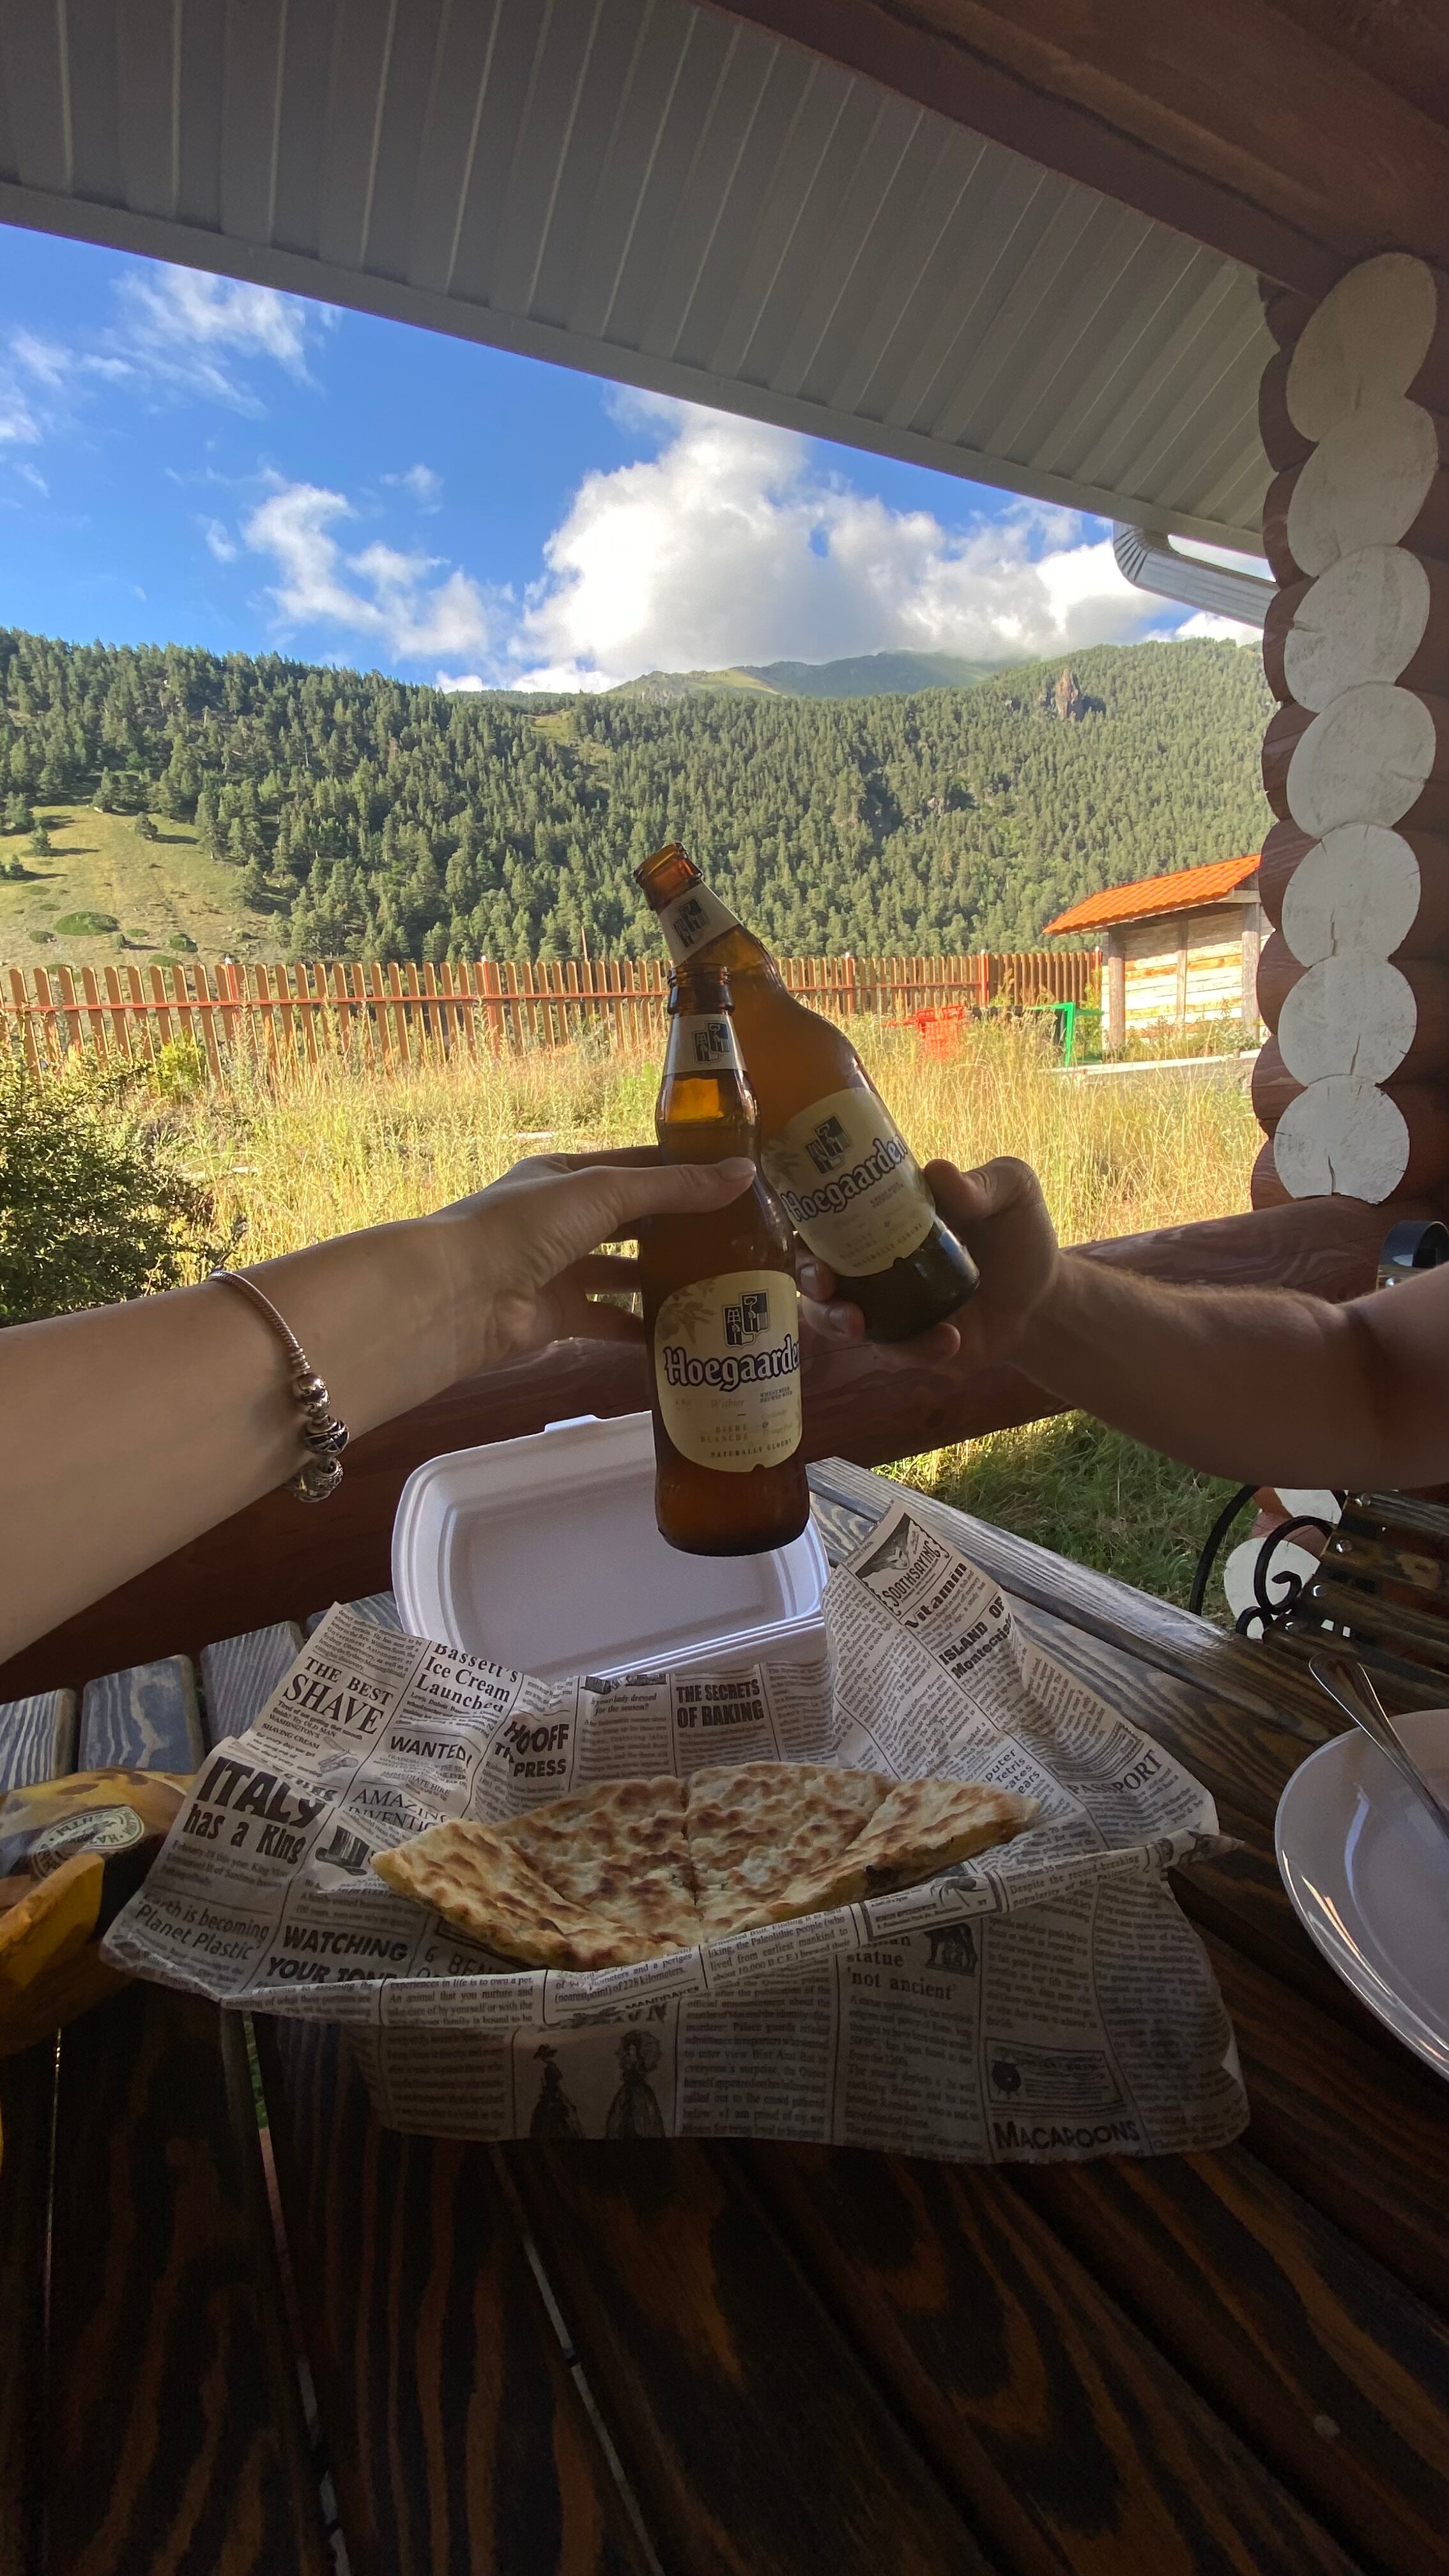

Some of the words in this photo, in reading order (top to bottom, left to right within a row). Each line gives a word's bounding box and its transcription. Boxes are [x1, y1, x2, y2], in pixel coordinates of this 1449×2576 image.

[780, 1133, 908, 1222] Hoegaarden
[710, 1446, 763, 1458] NATURALLY
[767, 1438, 792, 1452] CLOUDY
[882, 1540, 941, 1607] SOOTHSAYING
[905, 1563, 967, 1628] Vitamin
[938, 1621, 988, 1666] ISLAND
[988, 1596, 1006, 1618] OF
[871, 1642, 895, 1675] preparation
[305, 1657, 343, 1683] THE
[346, 1676, 394, 1706] BEST
[415, 1672, 505, 1713] Launched
[424, 1656, 451, 1678] Ice
[455, 1668, 510, 1703] Cream
[676, 1684, 703, 1703] THE
[704, 1679, 760, 1701] SECRETS
[282, 1673, 387, 1735] SHAVE
[631, 1693, 657, 1702] dressed
[677, 1706, 698, 1728] OF
[702, 1699, 765, 1726] BAKING
[261, 1723, 293, 1738] SHAVING
[293, 1735, 321, 1749] CREAM
[513, 1759, 567, 1777] PRESS
[985, 1749, 1016, 1783] puter
[995, 1758, 1026, 1783] Tetris
[1004, 1764, 1033, 1790] rates
[1068, 1749, 1163, 1794] PASSPORT
[196, 1756, 326, 1828] ITALY
[1017, 1770, 1040, 1794] ears
[182, 1803, 226, 1840] has
[230, 1820, 252, 1848] a
[256, 1824, 307, 1864] King
[1009, 1879, 1045, 1895] Despite
[1049, 1873, 1064, 1884] the
[1068, 1855, 1140, 1880] record-breaking
[1013, 1887, 1060, 1907] popularity
[1065, 1882, 1075, 1891] of
[183, 1905, 199, 1923] is
[199, 1907, 270, 1949] becoming
[737, 1941, 749, 1951] the
[751, 1929, 794, 1947] Paleolithic
[796, 1922, 824, 1936] people
[824, 1915, 845, 1928] (who
[192, 1931, 256, 1961] Plastic
[283, 1925, 410, 1961] WATCHING
[710, 1957, 733, 1972] lived
[737, 1952, 758, 1964] from
[763, 1942, 794, 1956] earliest
[799, 1929, 835, 1946] mankind
[839, 1928, 848, 1936] to
[266, 1956, 332, 1984] YOUR
[633, 1963, 649, 1975] and
[662, 1953, 693, 1969] perigee
[712, 1970, 737, 1981] about
[738, 1961, 766, 1975] 10,000
[800, 1946, 830, 1958] brewed
[832, 1939, 850, 1950] their
[847, 1951, 904, 1967] statue
[389, 1993, 402, 2003] An
[406, 1991, 435, 2004] animal
[440, 1990, 456, 2001] that
[461, 1991, 477, 2002] you
[482, 1990, 513, 1999] nurture
[518, 1986, 533, 1997] and
[390, 1981, 440, 1991] experiences
[442, 1979, 450, 1987] in
[452, 1978, 468, 1987] life
[470, 1978, 477, 1986] is
[555, 1990, 587, 2004] (nearest
[587, 1986, 613, 2002] point)
[613, 1984, 623, 1994] of
[624, 1979, 639, 1991] 228
[737, 1989, 751, 1998] the
[451, 2003, 487, 2016] yourself
[496, 2002, 518, 2012] with
[520, 2001, 533, 2010] the
[473, 2016, 480, 2025] is
[482, 2016, 509, 2025] bound
[992, 2119, 1142, 2150] MACAROONS
